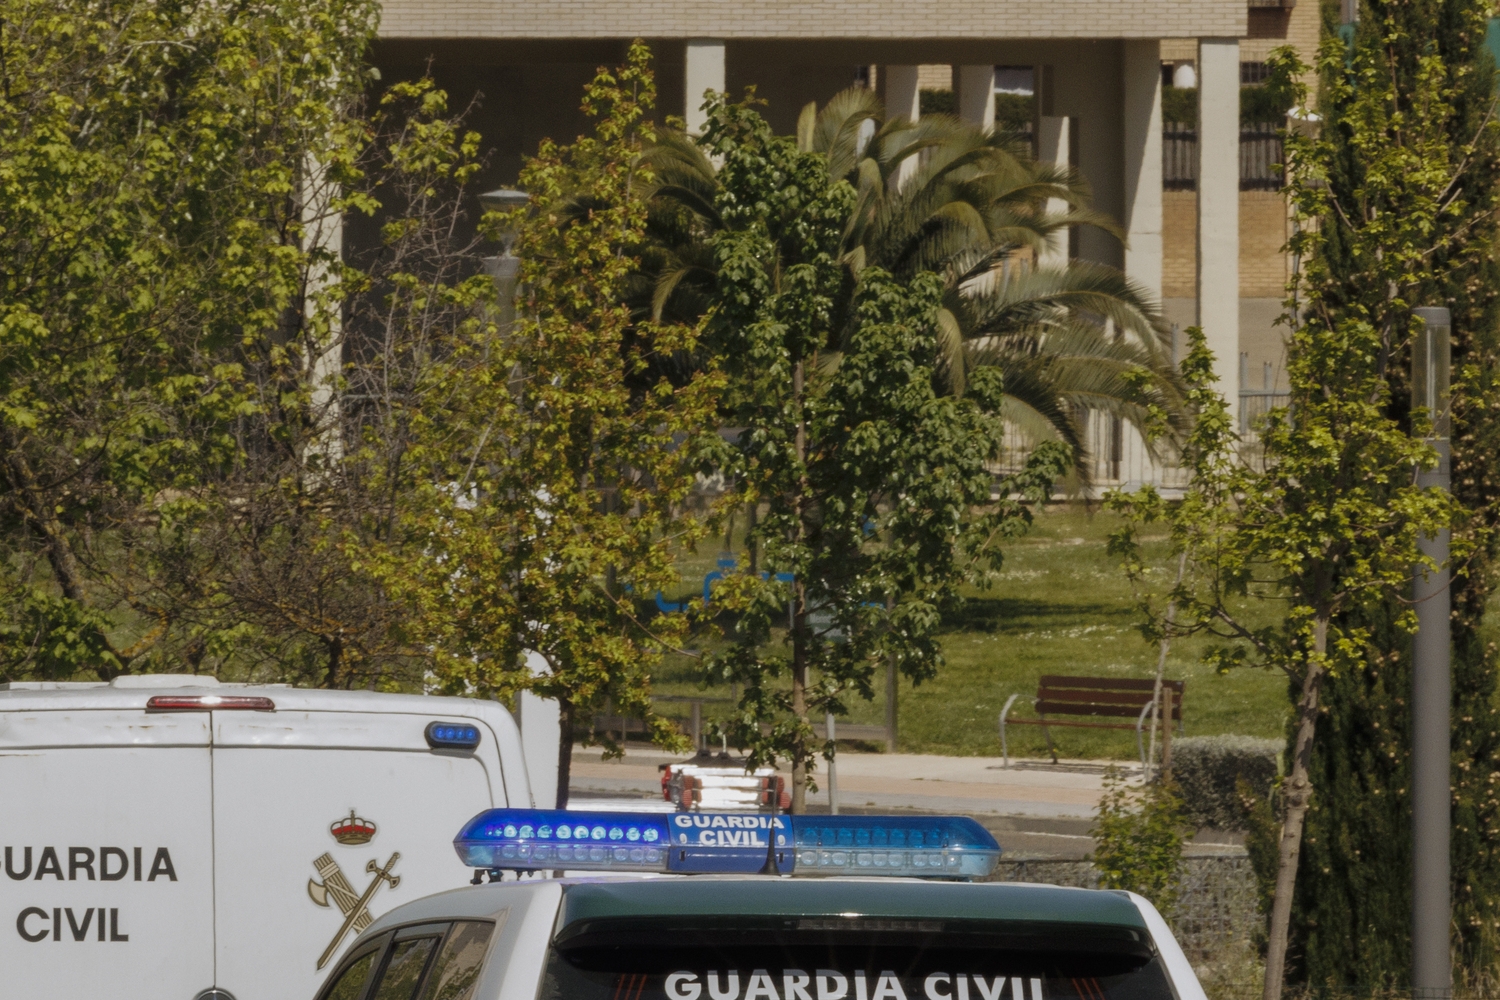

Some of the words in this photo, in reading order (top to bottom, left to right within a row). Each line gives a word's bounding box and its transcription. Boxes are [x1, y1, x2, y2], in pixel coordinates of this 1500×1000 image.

[674, 814, 785, 829] GUARDIA
[699, 830, 765, 846] CIVIL
[16, 906, 130, 943] CIVIL
